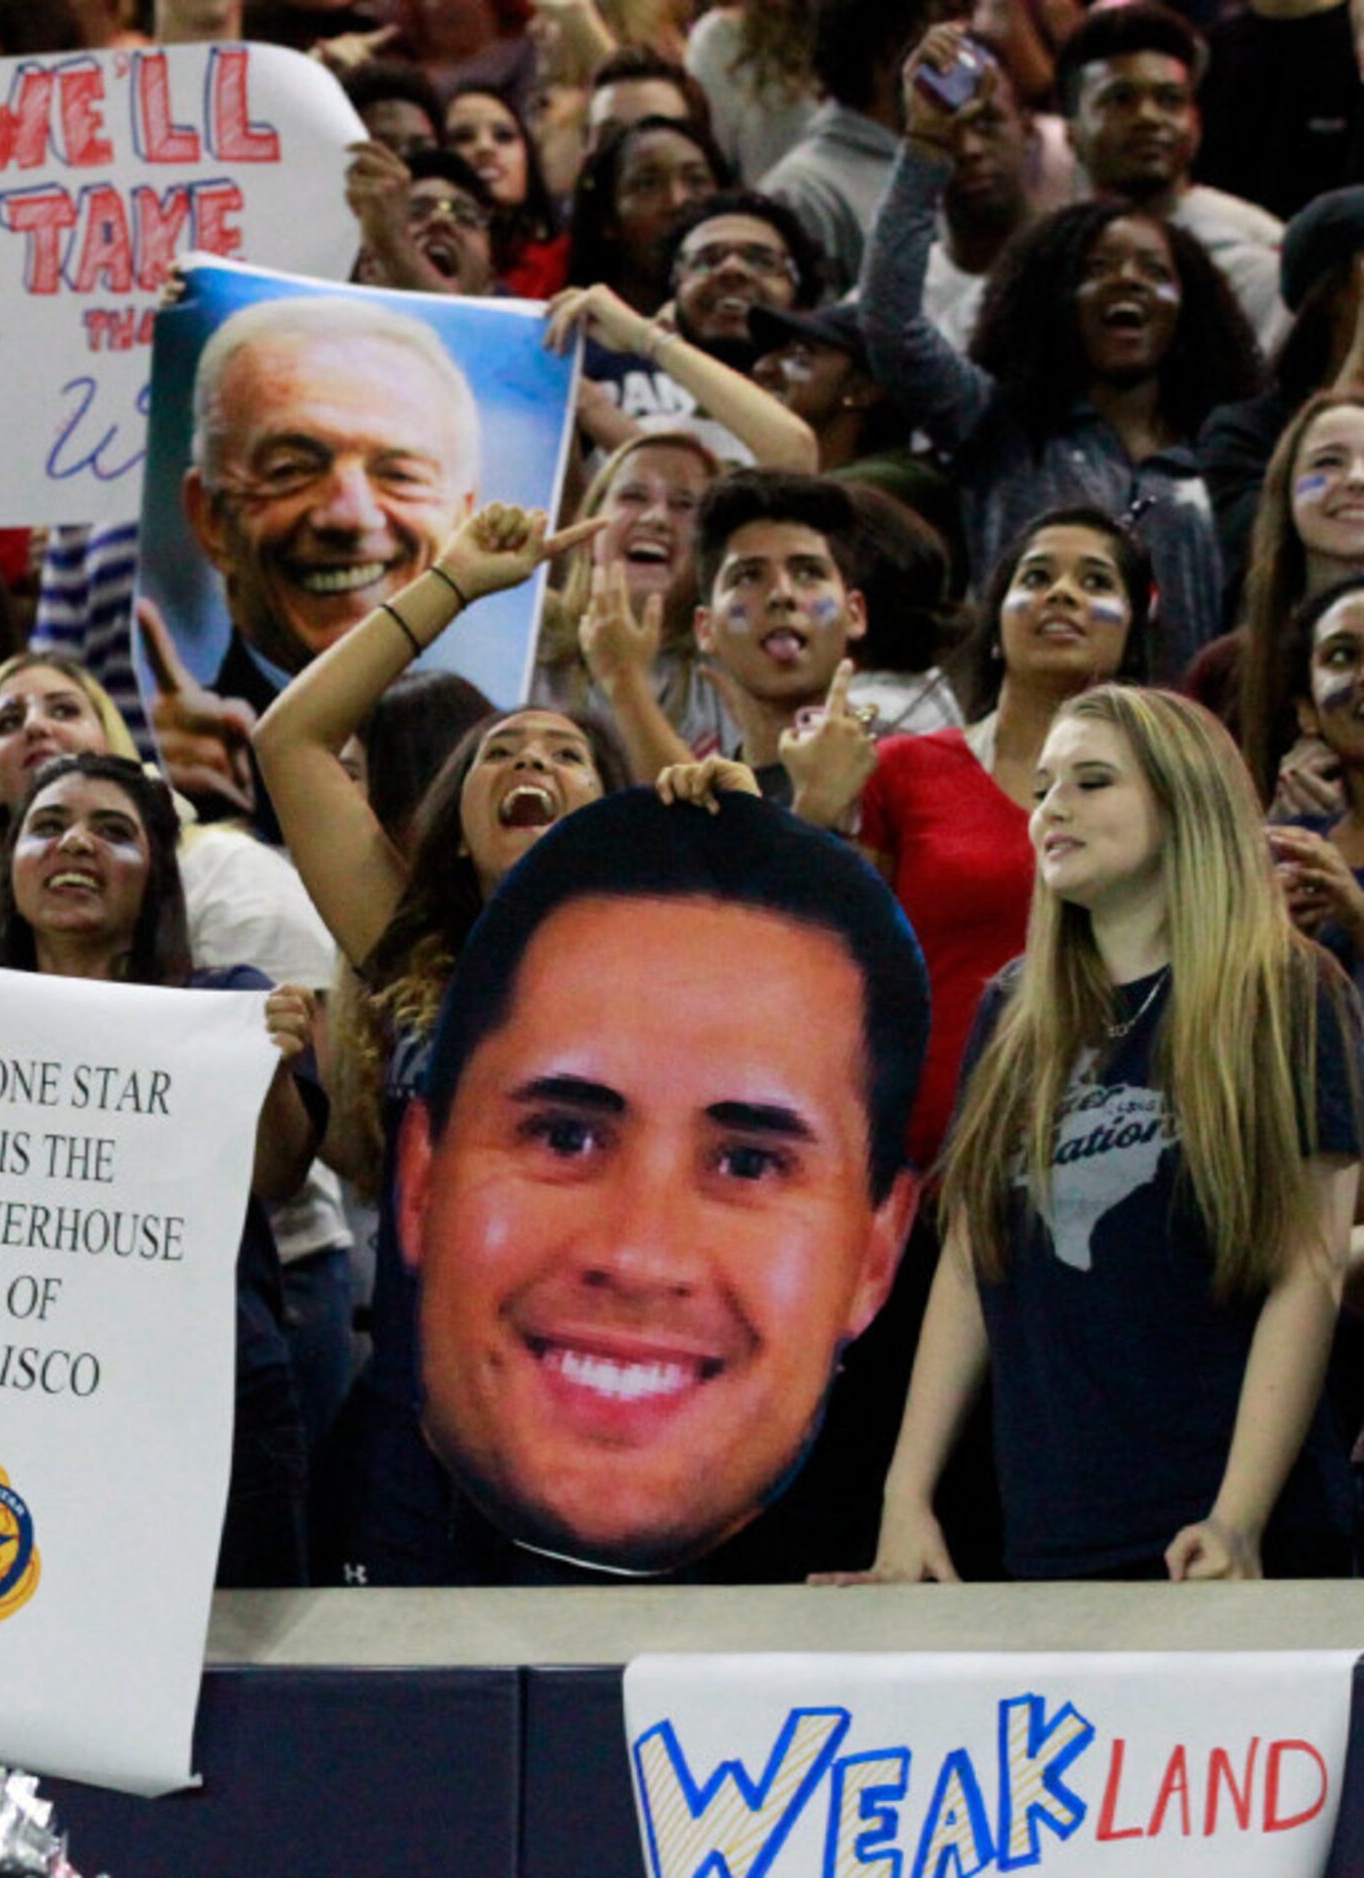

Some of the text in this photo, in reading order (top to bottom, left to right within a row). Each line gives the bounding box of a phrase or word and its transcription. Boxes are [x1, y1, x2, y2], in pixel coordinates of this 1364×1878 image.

[70, 1064, 172, 1115] STAR
[43, 1134, 116, 1183] THE
[6, 1275, 62, 1321] OF
